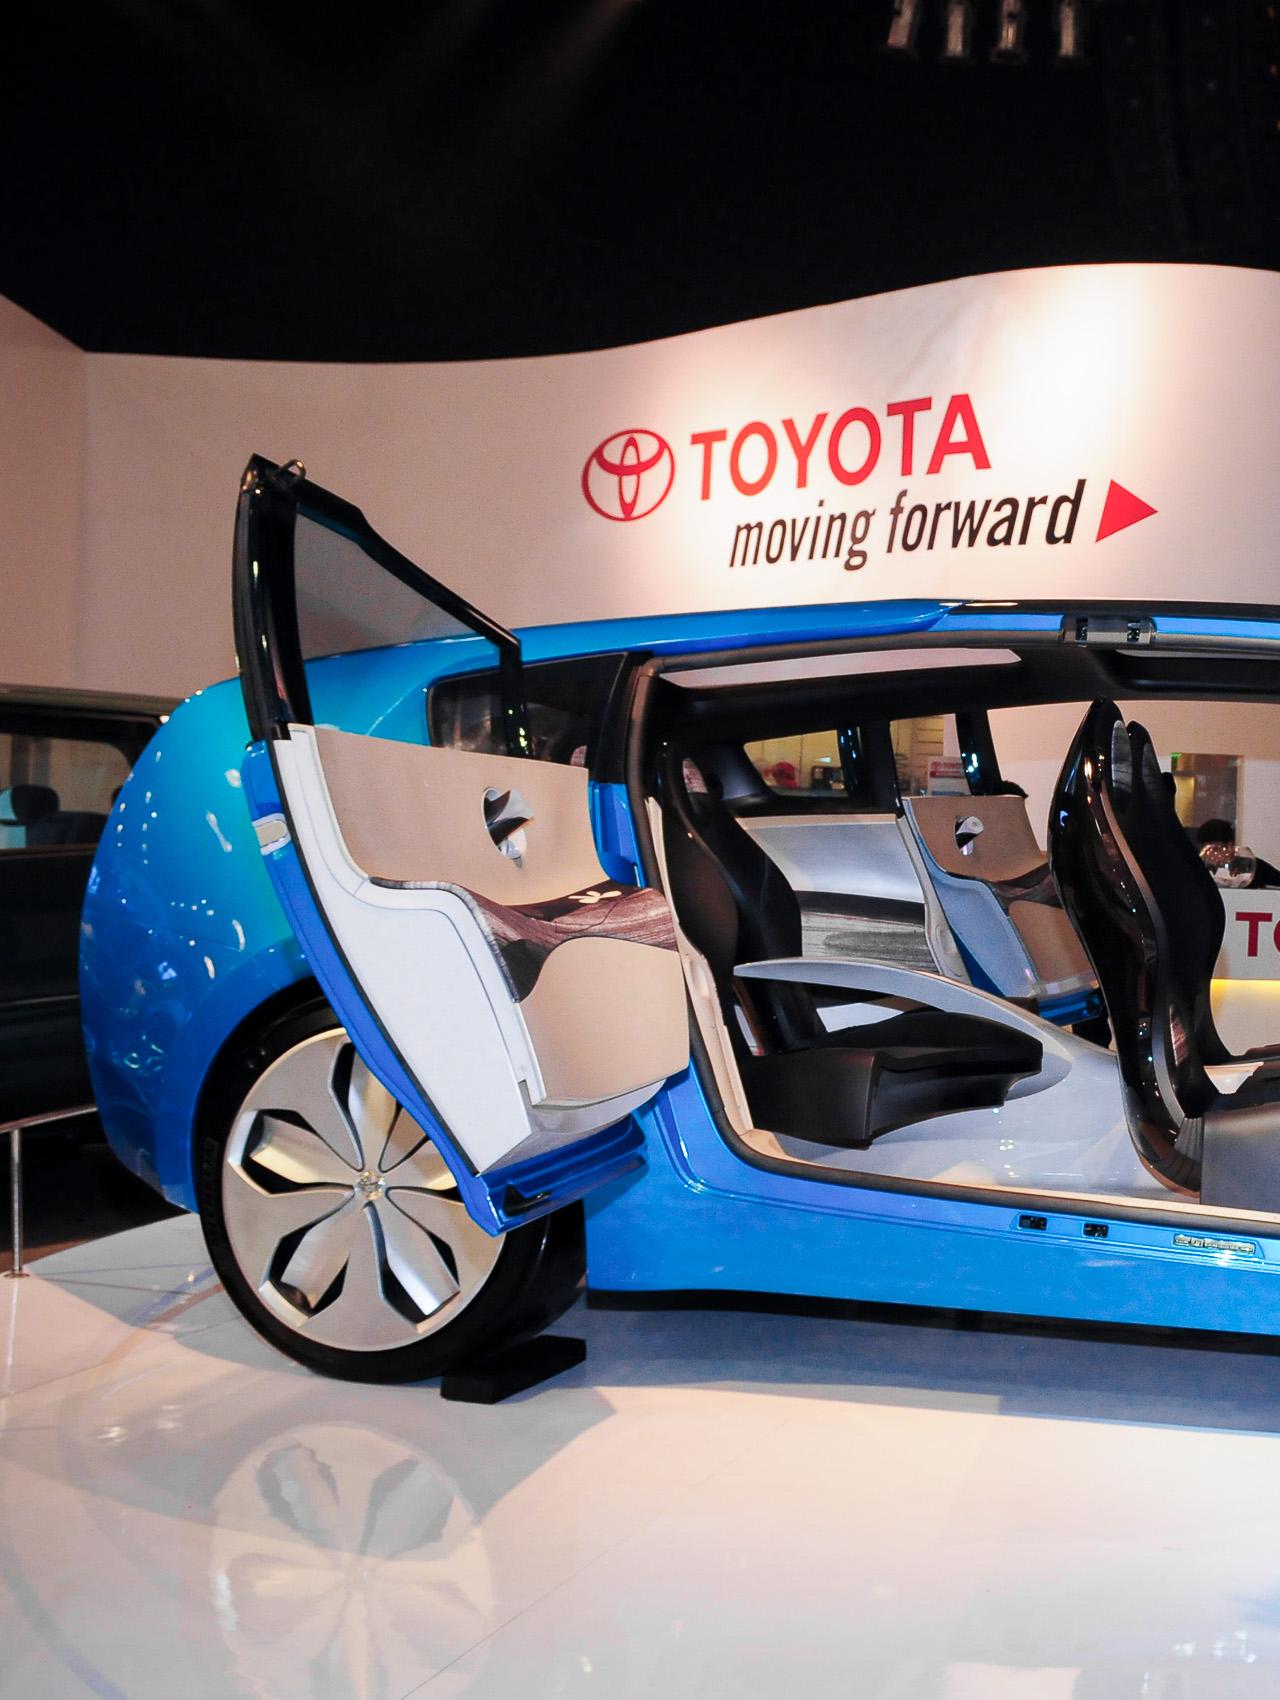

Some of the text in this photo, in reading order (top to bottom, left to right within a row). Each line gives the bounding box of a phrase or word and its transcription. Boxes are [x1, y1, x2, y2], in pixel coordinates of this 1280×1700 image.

[691, 393, 991, 500] TOYOTA
[728, 478, 1087, 571] moving forward
